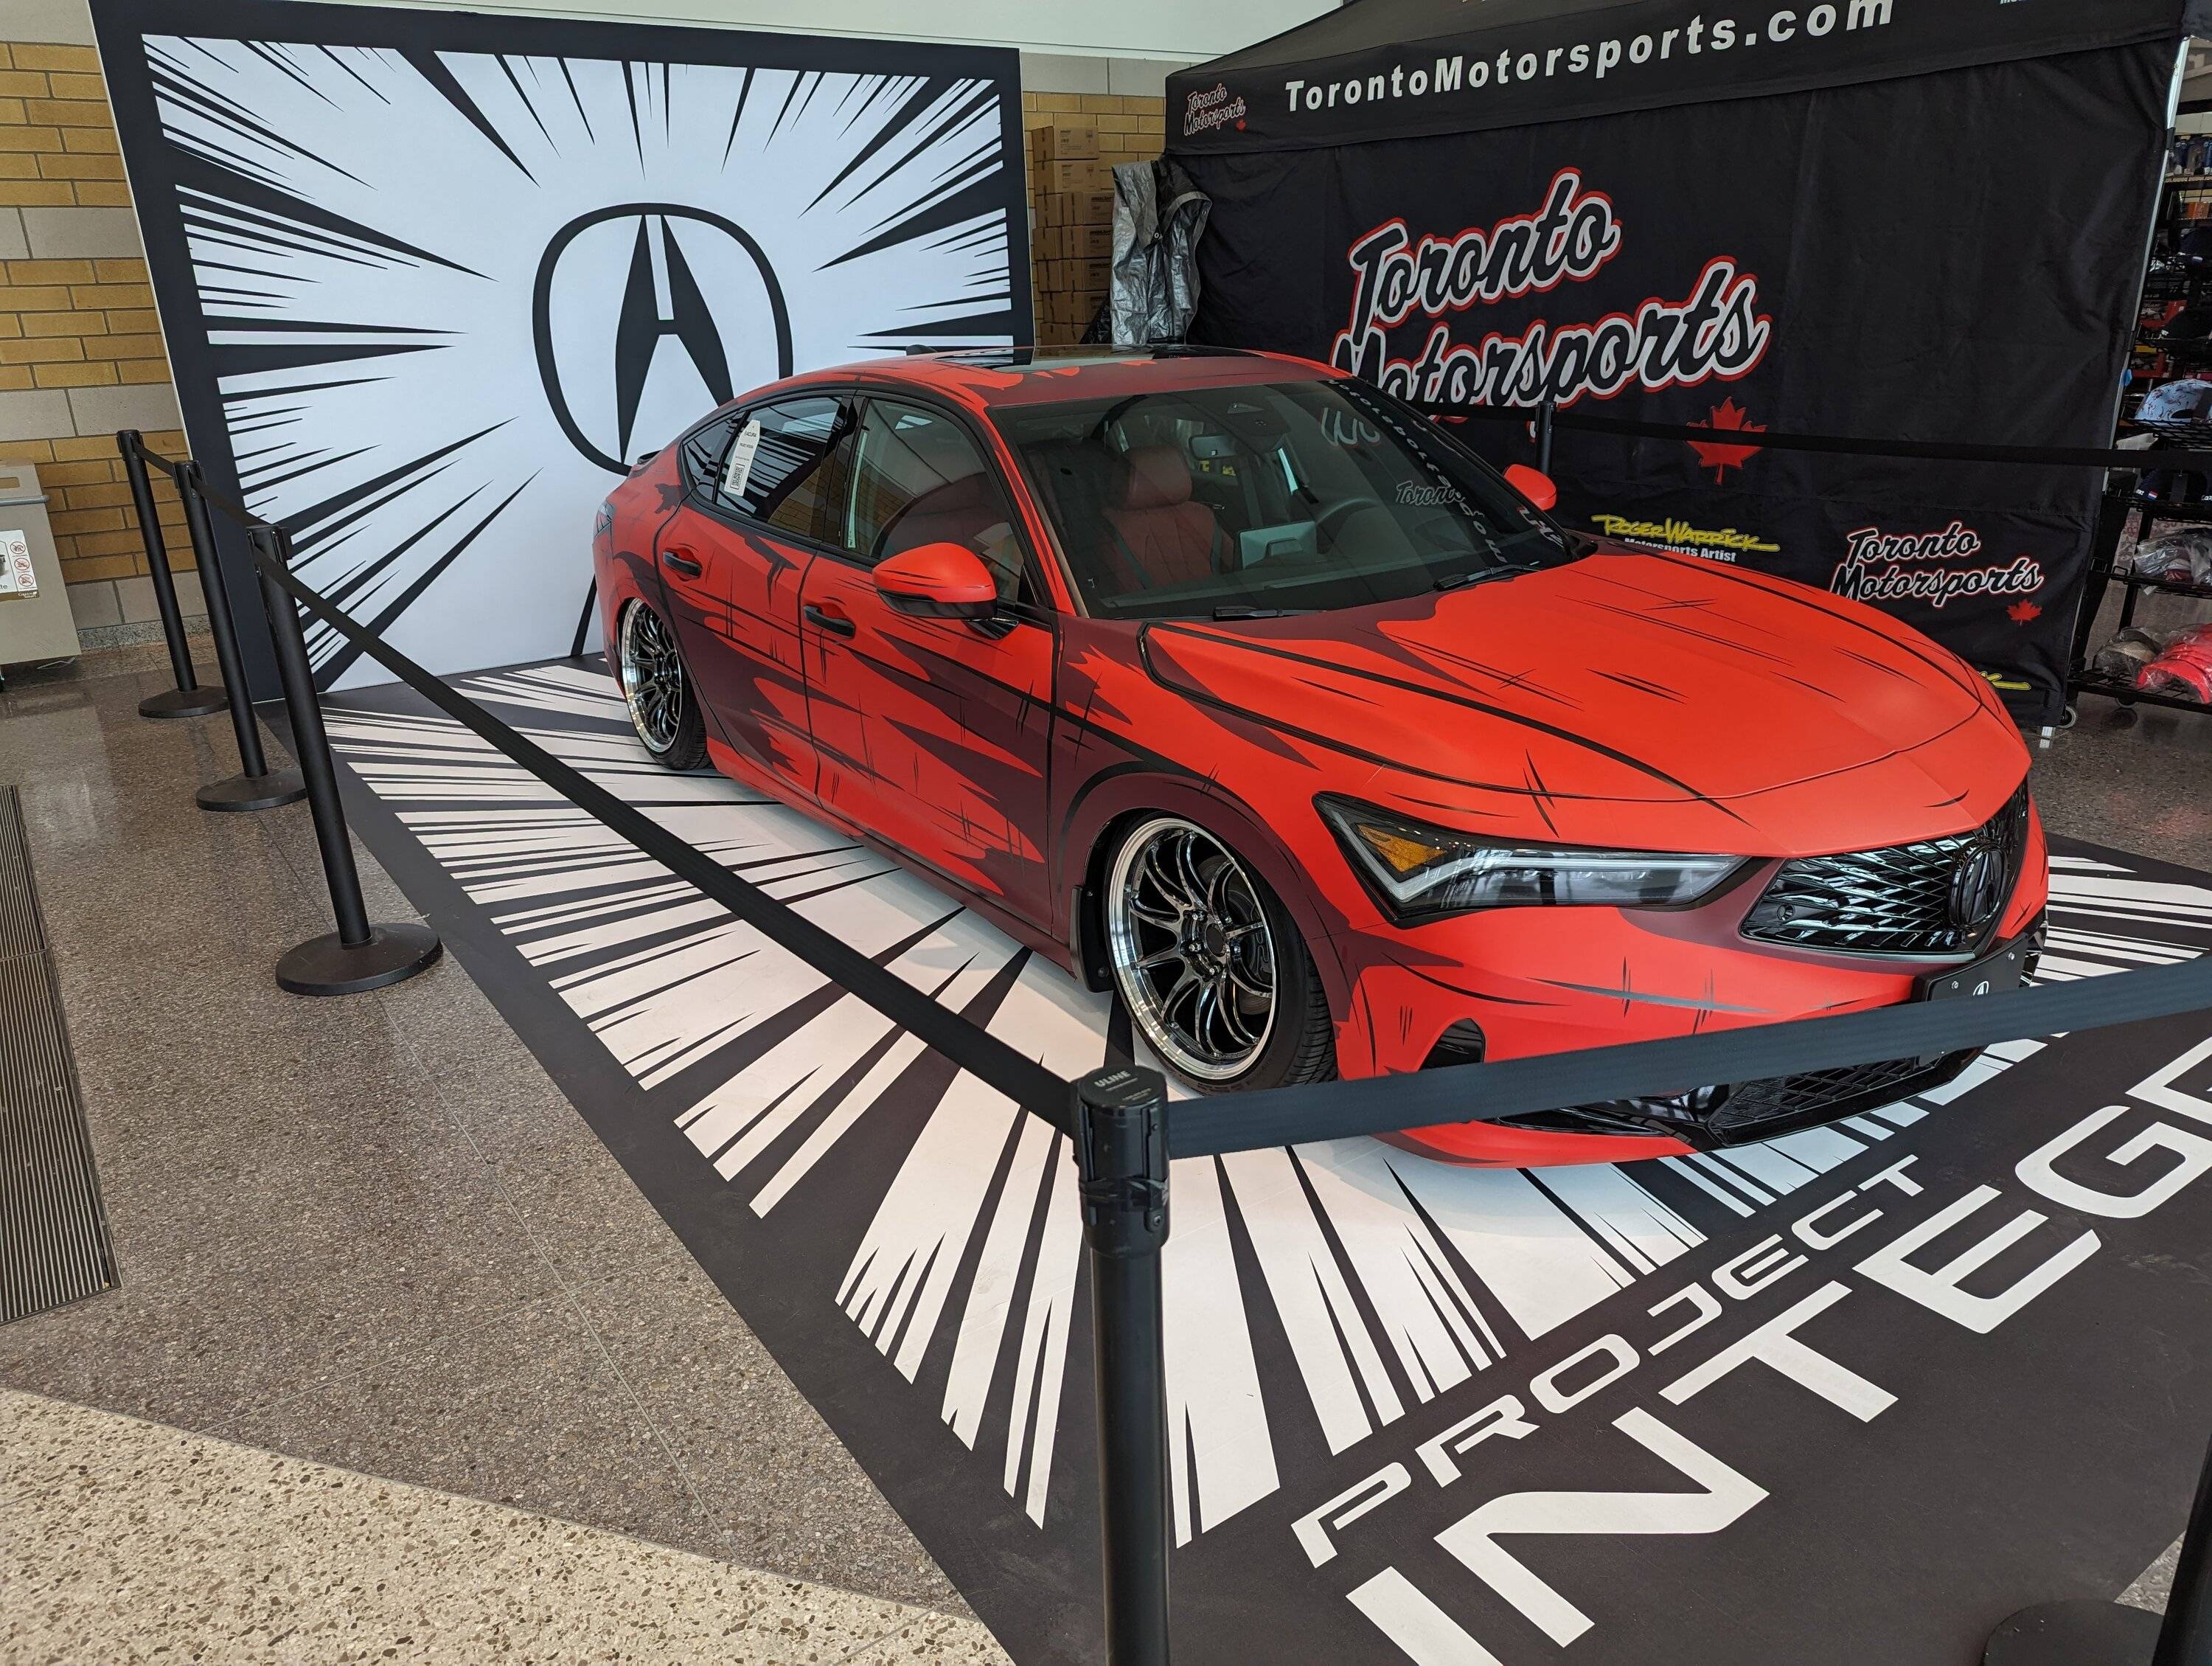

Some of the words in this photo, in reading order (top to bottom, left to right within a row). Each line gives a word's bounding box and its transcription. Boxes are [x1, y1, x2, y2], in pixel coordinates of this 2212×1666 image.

[1285, 0, 1893, 111] TorontoMotorsports.com
[1183, 96, 1246, 136] Motorsports
[1187, 83, 1228, 116] Toronto
[1348, 166, 1622, 347] Toronto
[1701, 547, 1736, 562] Artist
[1846, 519, 1981, 570] Toronto
[1829, 555, 2045, 608] Motorsports
[1093, 1070, 1131, 1088] ULINE
[1290, 1154, 1919, 1569] PROJECT
